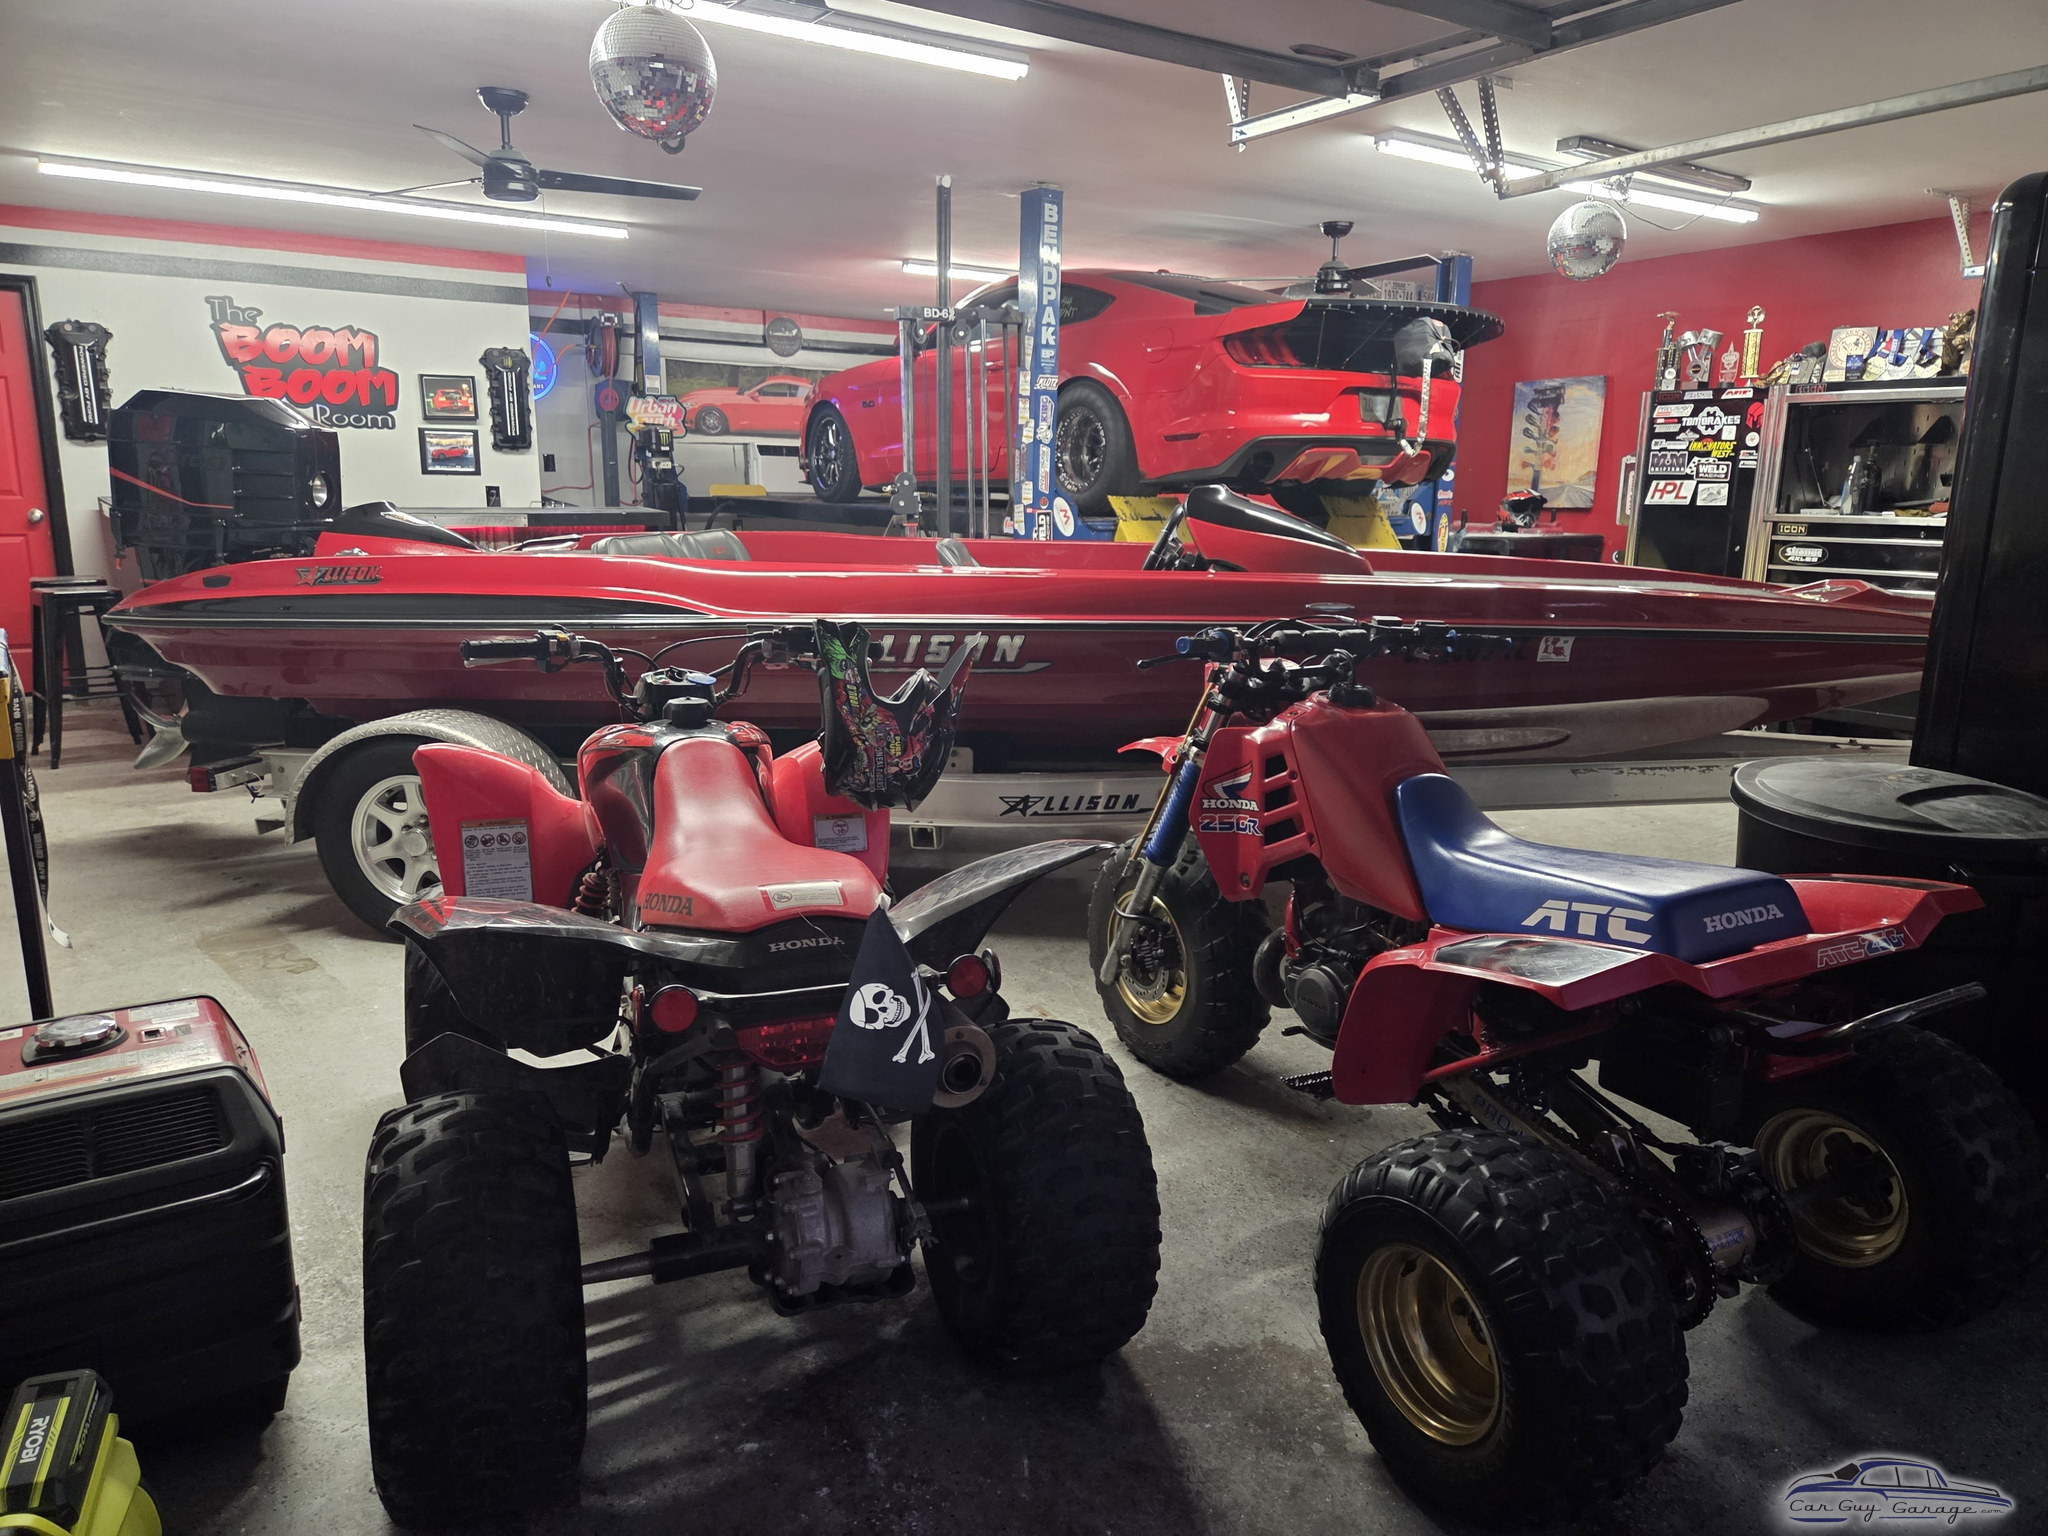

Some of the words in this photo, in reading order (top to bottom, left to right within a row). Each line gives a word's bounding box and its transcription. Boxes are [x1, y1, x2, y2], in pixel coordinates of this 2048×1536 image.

[1041, 203, 1060, 345] BENDPAK
[208, 297, 260, 323] The
[219, 322, 375, 368] BOOM
[78, 345, 89, 387] POWERED
[84, 387, 91, 400] BY
[1039, 378, 1058, 388] KLOTZ
[242, 365, 396, 406] BOOM
[1660, 392, 1681, 400] ICON
[315, 403, 393, 428] Room
[628, 398, 677, 414] Urban
[1701, 415, 1741, 425] BRAKES
[1689, 440, 1737, 451] INNOVATORS
[1711, 450, 1731, 458] WEST
[1699, 465, 1727, 473] WELD
[1650, 482, 1688, 500] HPL
[1780, 525, 1806, 533] ICON
[999, 794, 1140, 817] ALLISON
[1202, 799, 1259, 811] HONDA
[1199, 814, 1263, 836] 250R
[642, 893, 693, 916] HONDA
[1521, 899, 1655, 945] ATC
[1703, 904, 1785, 933] HONDA
[768, 936, 845, 953] HONDA
[1817, 941, 1865, 968] ATC
[19, 1415, 50, 1464] RYOBI
